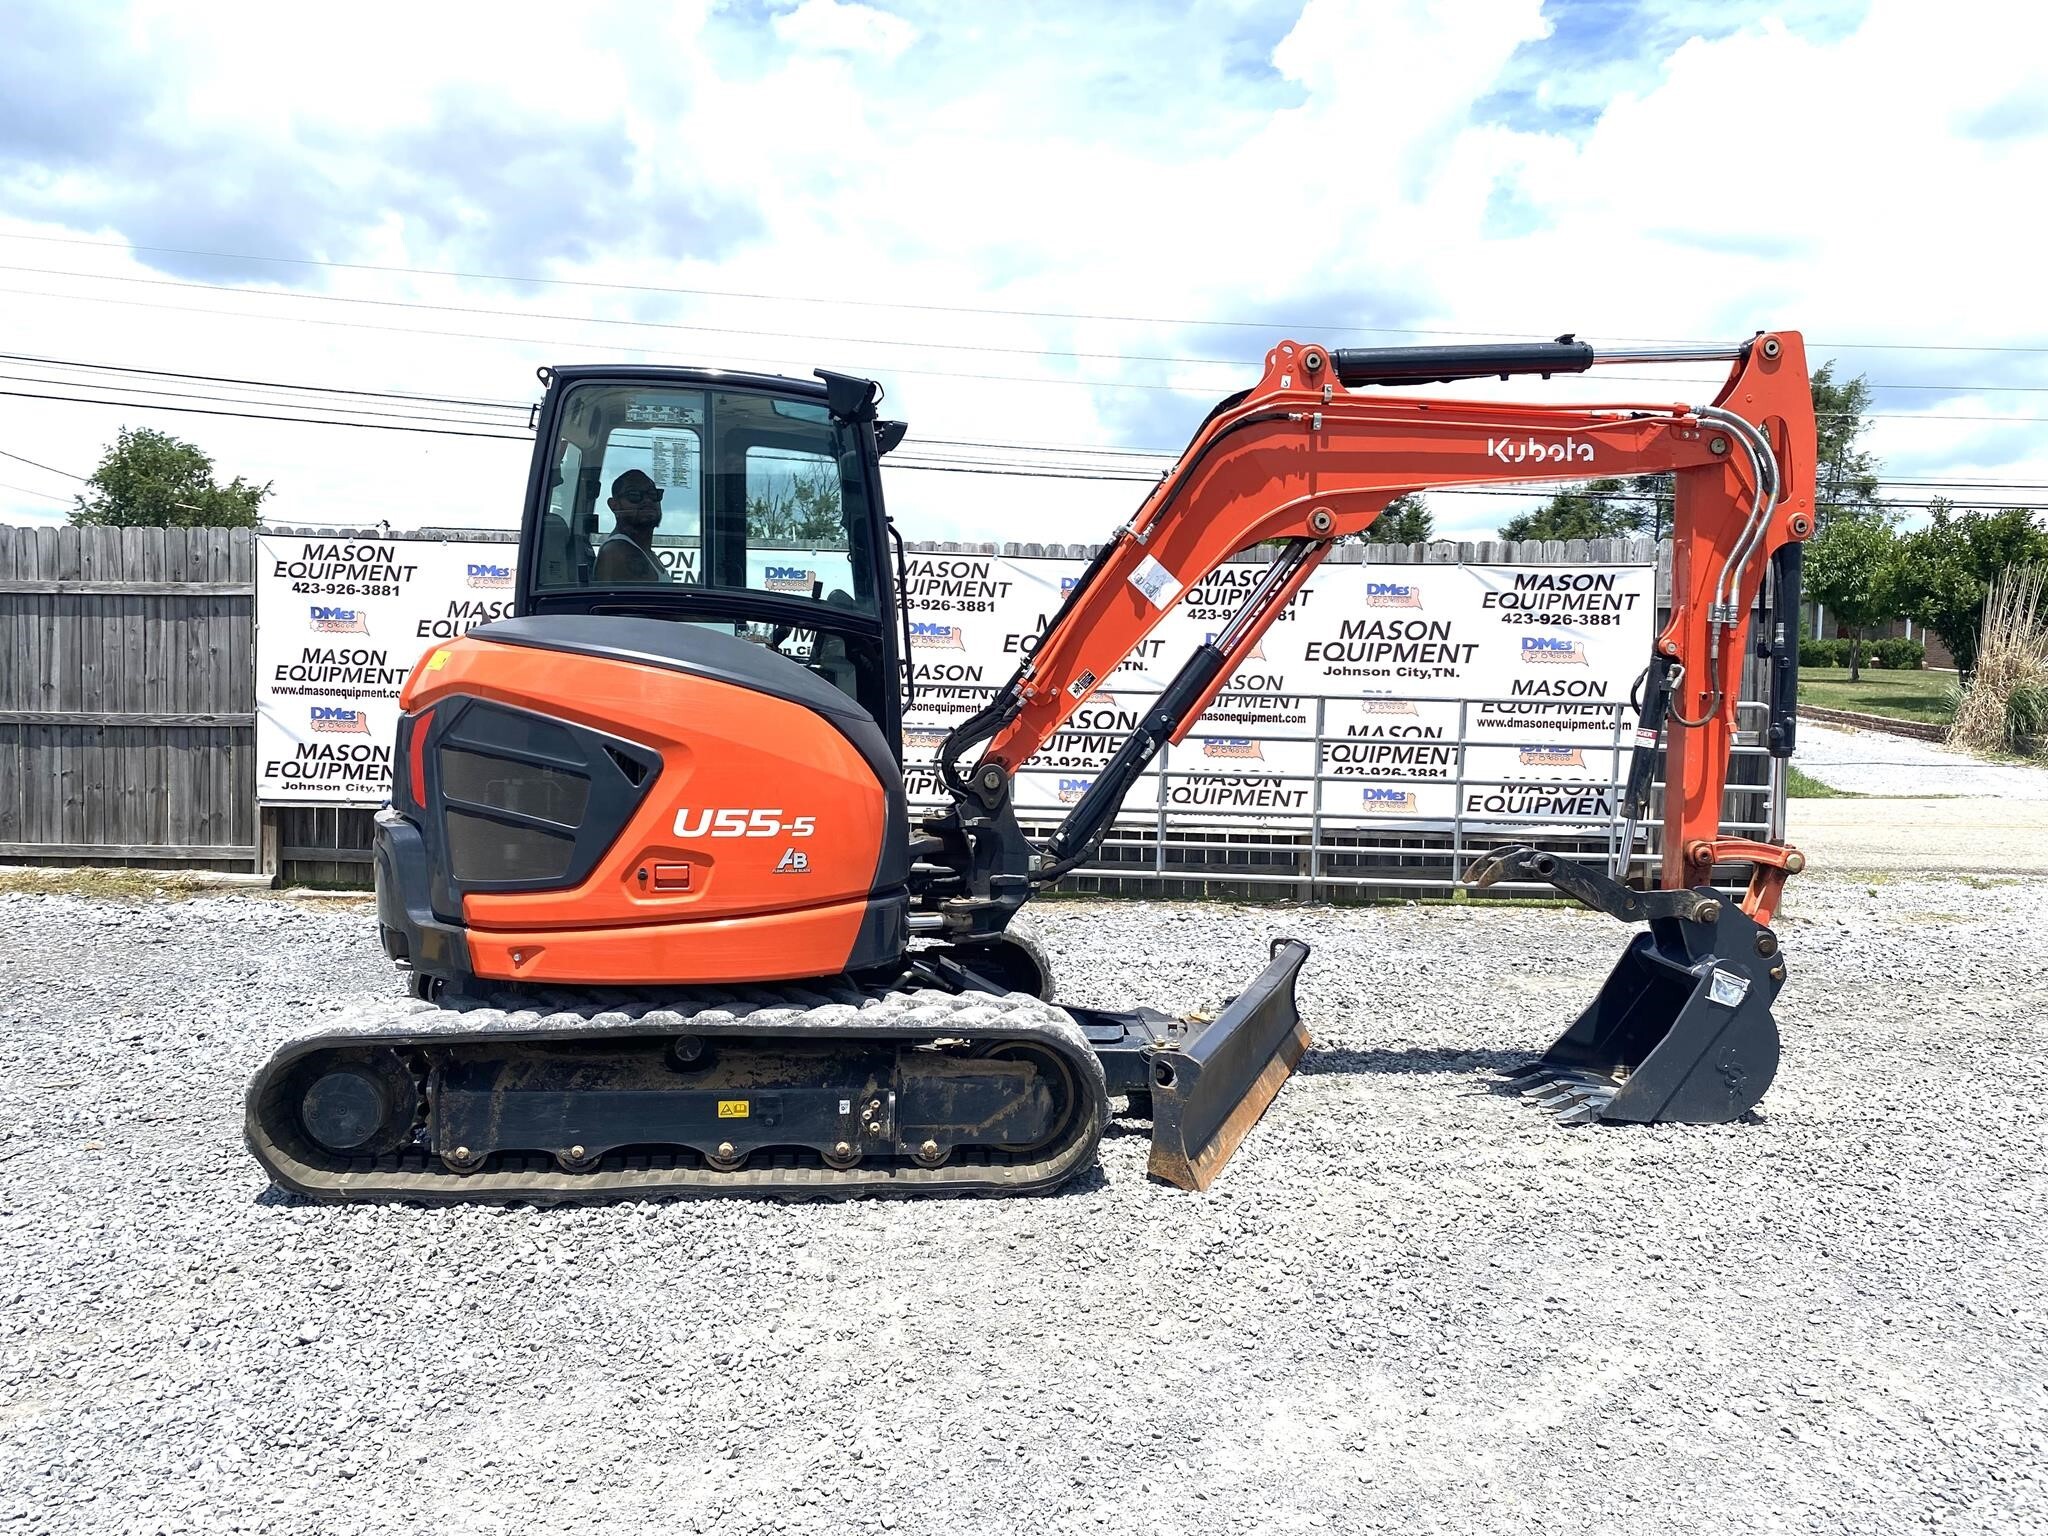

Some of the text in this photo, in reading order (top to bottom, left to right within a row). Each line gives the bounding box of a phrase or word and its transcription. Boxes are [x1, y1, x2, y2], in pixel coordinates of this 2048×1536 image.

[1487, 436, 1594, 463] Kubota
[302, 543, 395, 562] MASON
[274, 561, 418, 582] EQUIPMENT
[1199, 569, 1290, 587] MAS
[291, 582, 400, 596] 423-926-3881
[1514, 574, 1615, 591] MASON
[447, 600, 515, 620] MASO
[1482, 592, 1640, 611] EQUIPMENT
[1501, 613, 1621, 626] 423-926-3881
[1339, 619, 1451, 641] MASON
[301, 647, 387, 666] MASON
[1304, 641, 1479, 664] EQUIPMENT
[274, 664, 409, 685] EQUIPMENT
[1322, 665, 1461, 680] Johnson City,TN.
[1222, 674, 1284, 691] ASON
[1511, 679, 1608, 697] MASON
[271, 685, 400, 700] www.dmasonequipment.co
[1063, 709, 1139, 730] ASON
[1477, 717, 1632, 732] www.dmasonequipment.cm
[296, 743, 391, 762] MASON
[264, 761, 393, 781] EQUIPMEN
[281, 782, 340, 792] Johnson
[672, 808, 816, 838] U55-5
[776, 847, 809, 870] AB
